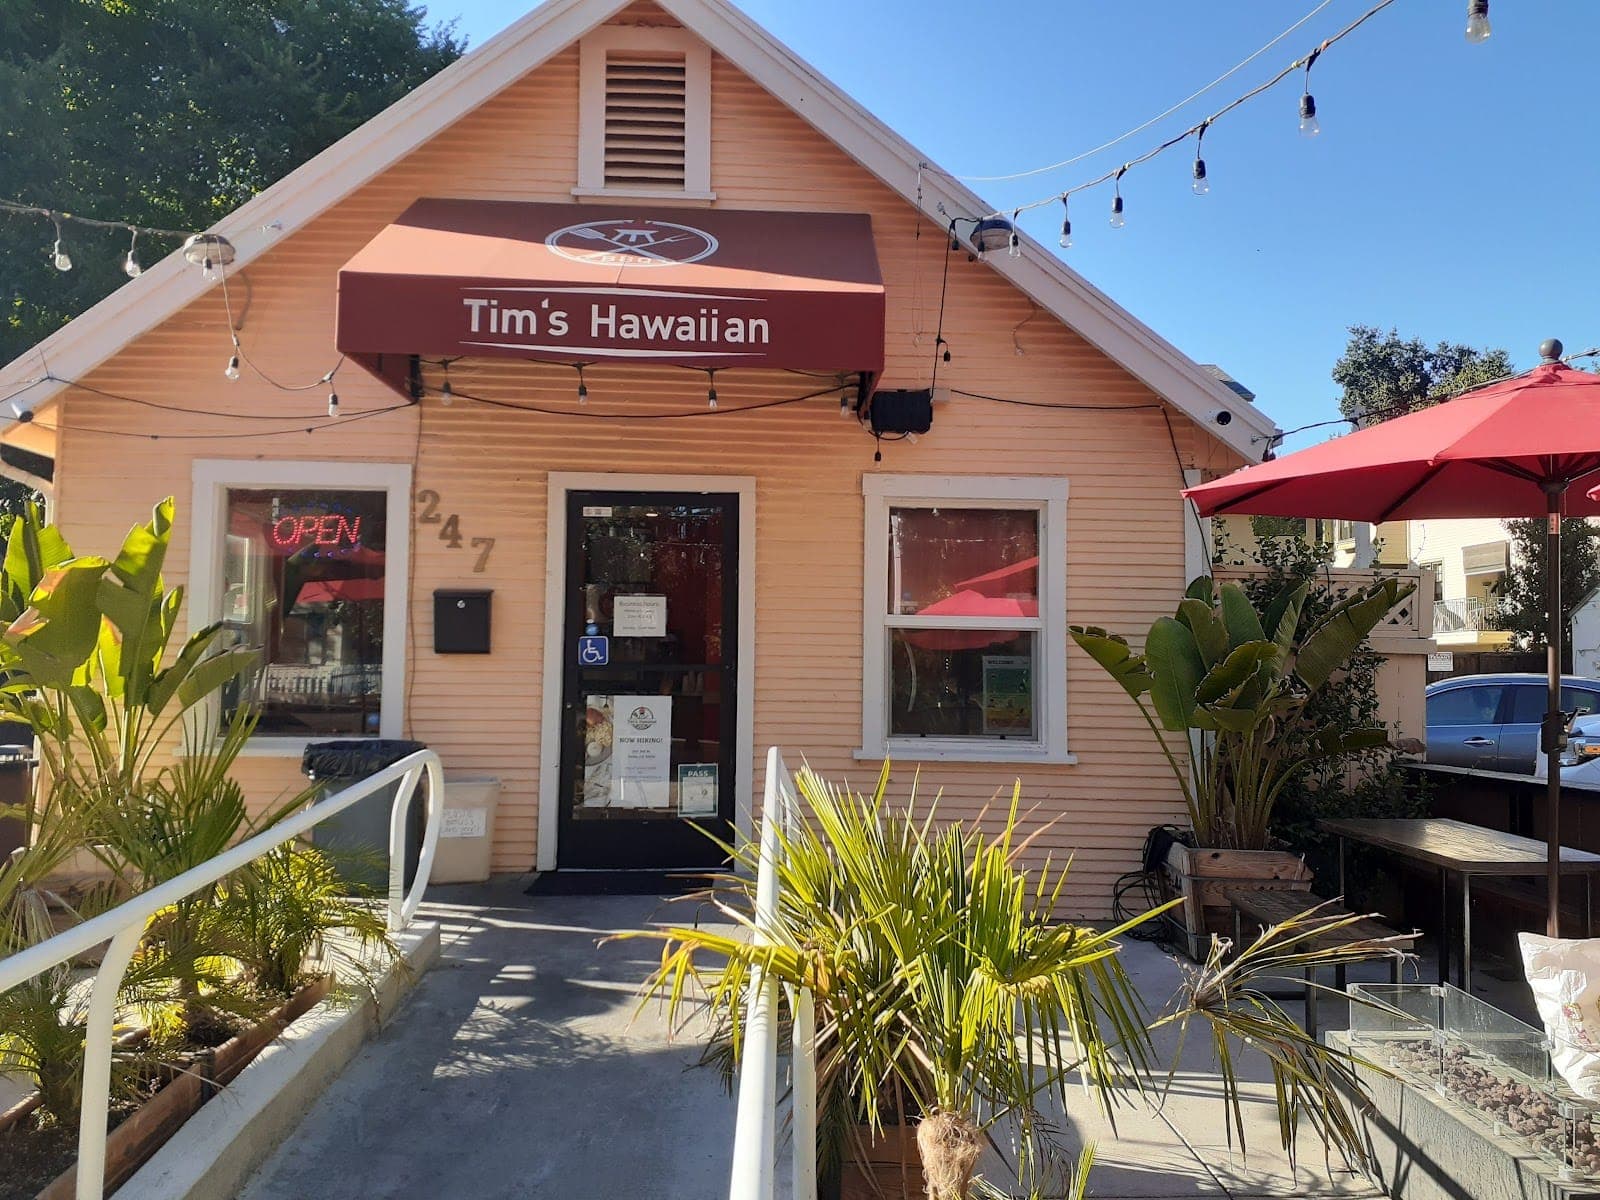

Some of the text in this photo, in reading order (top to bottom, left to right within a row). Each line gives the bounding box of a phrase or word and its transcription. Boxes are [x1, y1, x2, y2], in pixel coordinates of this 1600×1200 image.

[600, 256, 652, 265] BBQ
[463, 297, 770, 344] Tim's Hawaiian
[273, 515, 359, 545] OPEN
